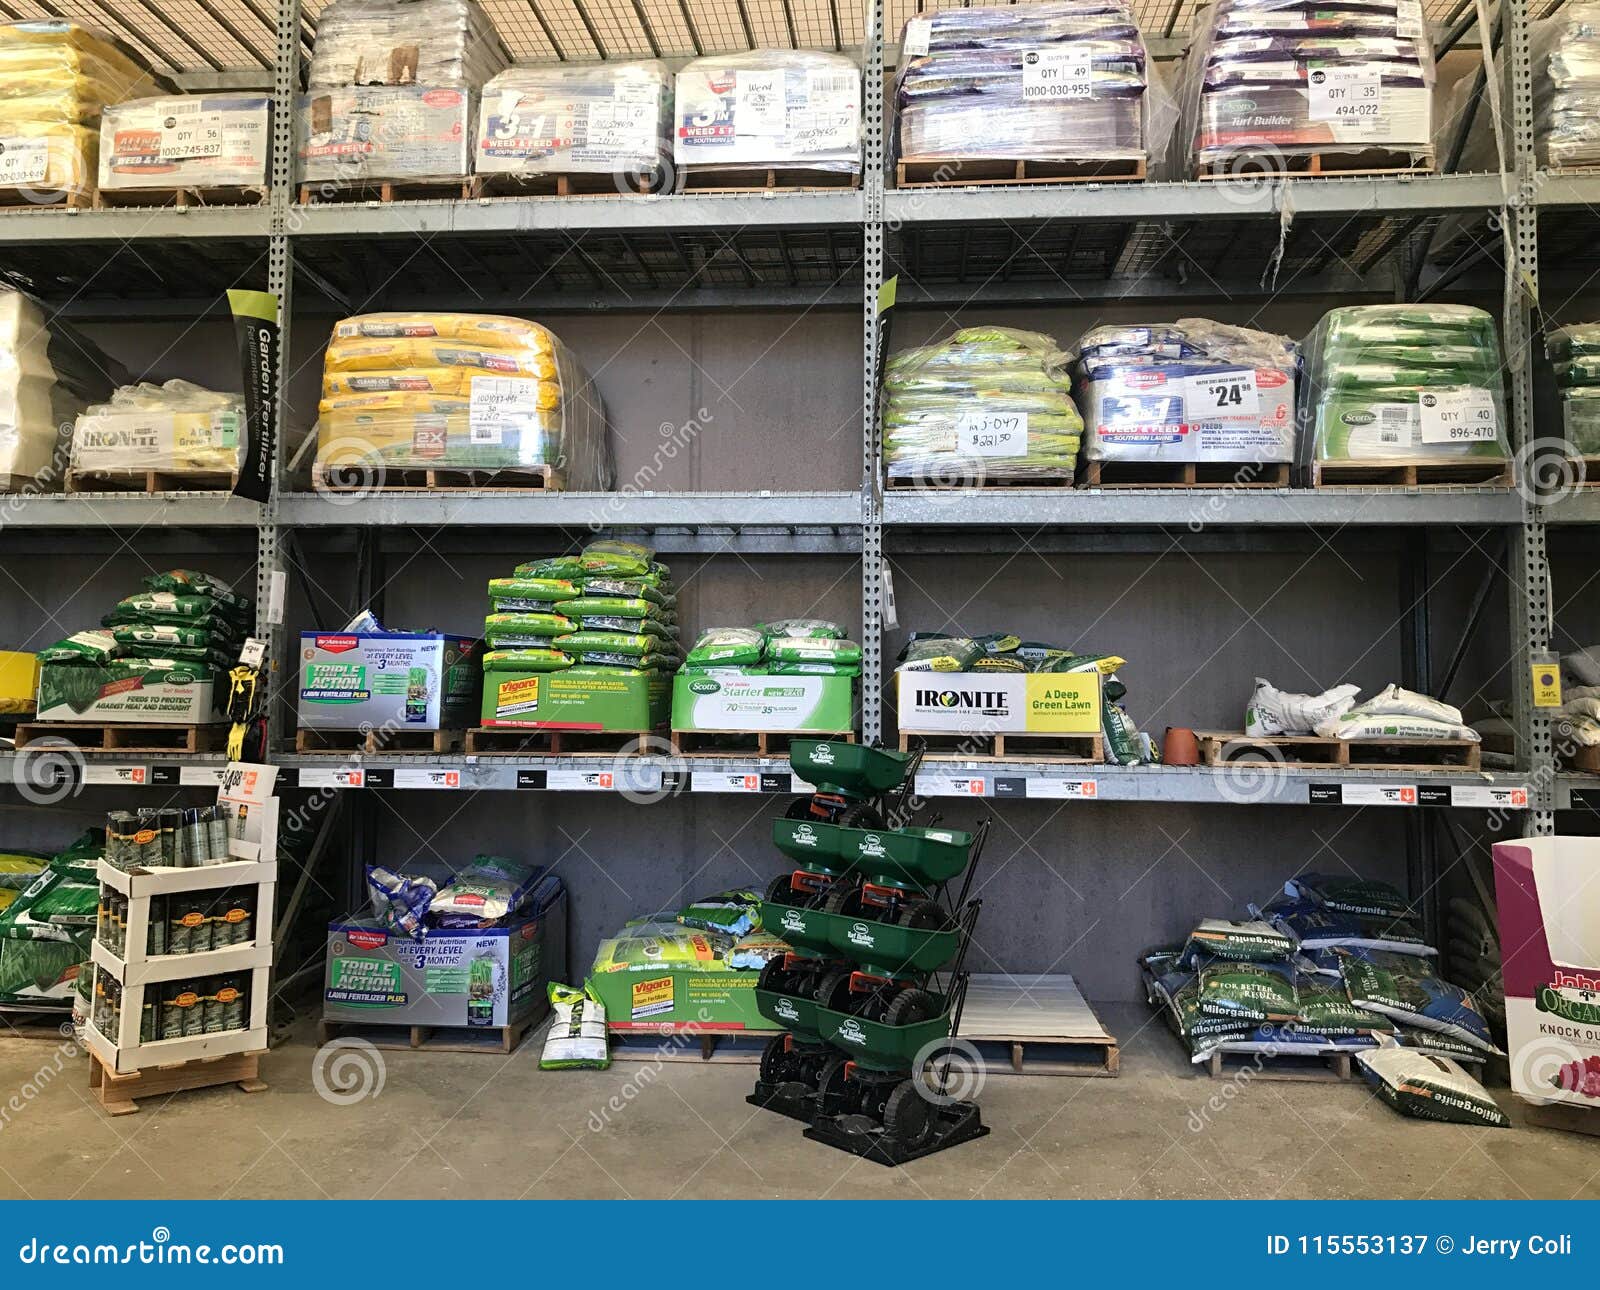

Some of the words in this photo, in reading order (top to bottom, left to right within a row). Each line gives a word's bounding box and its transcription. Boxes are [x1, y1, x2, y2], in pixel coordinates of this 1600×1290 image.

[1041, 68, 1058, 79] QTY
[1074, 67, 1086, 77] 49
[1024, 84, 1090, 96] 1000-030-955
[1328, 89, 1346, 99] QTY
[1363, 87, 1376, 97] 35
[1335, 104, 1378, 115] 494-022
[1254, 115, 1293, 126] Builder
[178, 133, 192, 141] QTY
[207, 129, 217, 138] 56
[686, 127, 715, 136] WEED
[162, 144, 220, 156] 1002-745-837
[258, 328, 271, 395] Garden
[1345, 412, 1372, 423] Scotts
[1440, 412, 1459, 422] QTY
[1477, 410, 1490, 420] 40
[1107, 425, 1137, 433] WEED
[1152, 425, 1180, 434] FEED
[1450, 427, 1494, 439] 896-470
[257, 399, 271, 483] Fertilizer
[312, 665, 361, 677] TRIPLE
[377, 660, 386, 670] 3
[309, 677, 362, 690] ACTION
[502, 680, 536, 692] Vigoro
[692, 682, 717, 691] Scotts
[723, 687, 762, 696] Starter
[1045, 690, 1053, 698] A
[1054, 690, 1079, 701] Deep
[915, 689, 1009, 708] IRONITE
[1032, 700, 1059, 709] Green
[1061, 700, 1091, 709] Lawn
[858, 933, 874, 942] Builder
[1229, 935, 1290, 949] Milorganite
[438, 946, 463, 954] LEVEL
[340, 960, 394, 976] TRIPLE
[415, 955, 425, 969] 3
[336, 976, 396, 992] ACTION
[635, 979, 671, 993] Vigoro
[1240, 983, 1273, 992] BETTER
[328, 992, 347, 1000] LAWN
[348, 993, 386, 1001] FERTILIZER
[387, 994, 405, 1002] PLUS
[1367, 994, 1417, 1012] Milorganite
[1202, 1004, 1265, 1020] Milorganite
[850, 1030, 866, 1038] Builder
[1191, 1022, 1249, 1036] Milorganite
[1294, 1025, 1355, 1035] Milorganite
[1539, 1023, 1582, 1039] KNOCK
[1423, 1038, 1473, 1053] Milorganite
[1434, 1093, 1501, 1123] Milorganite
